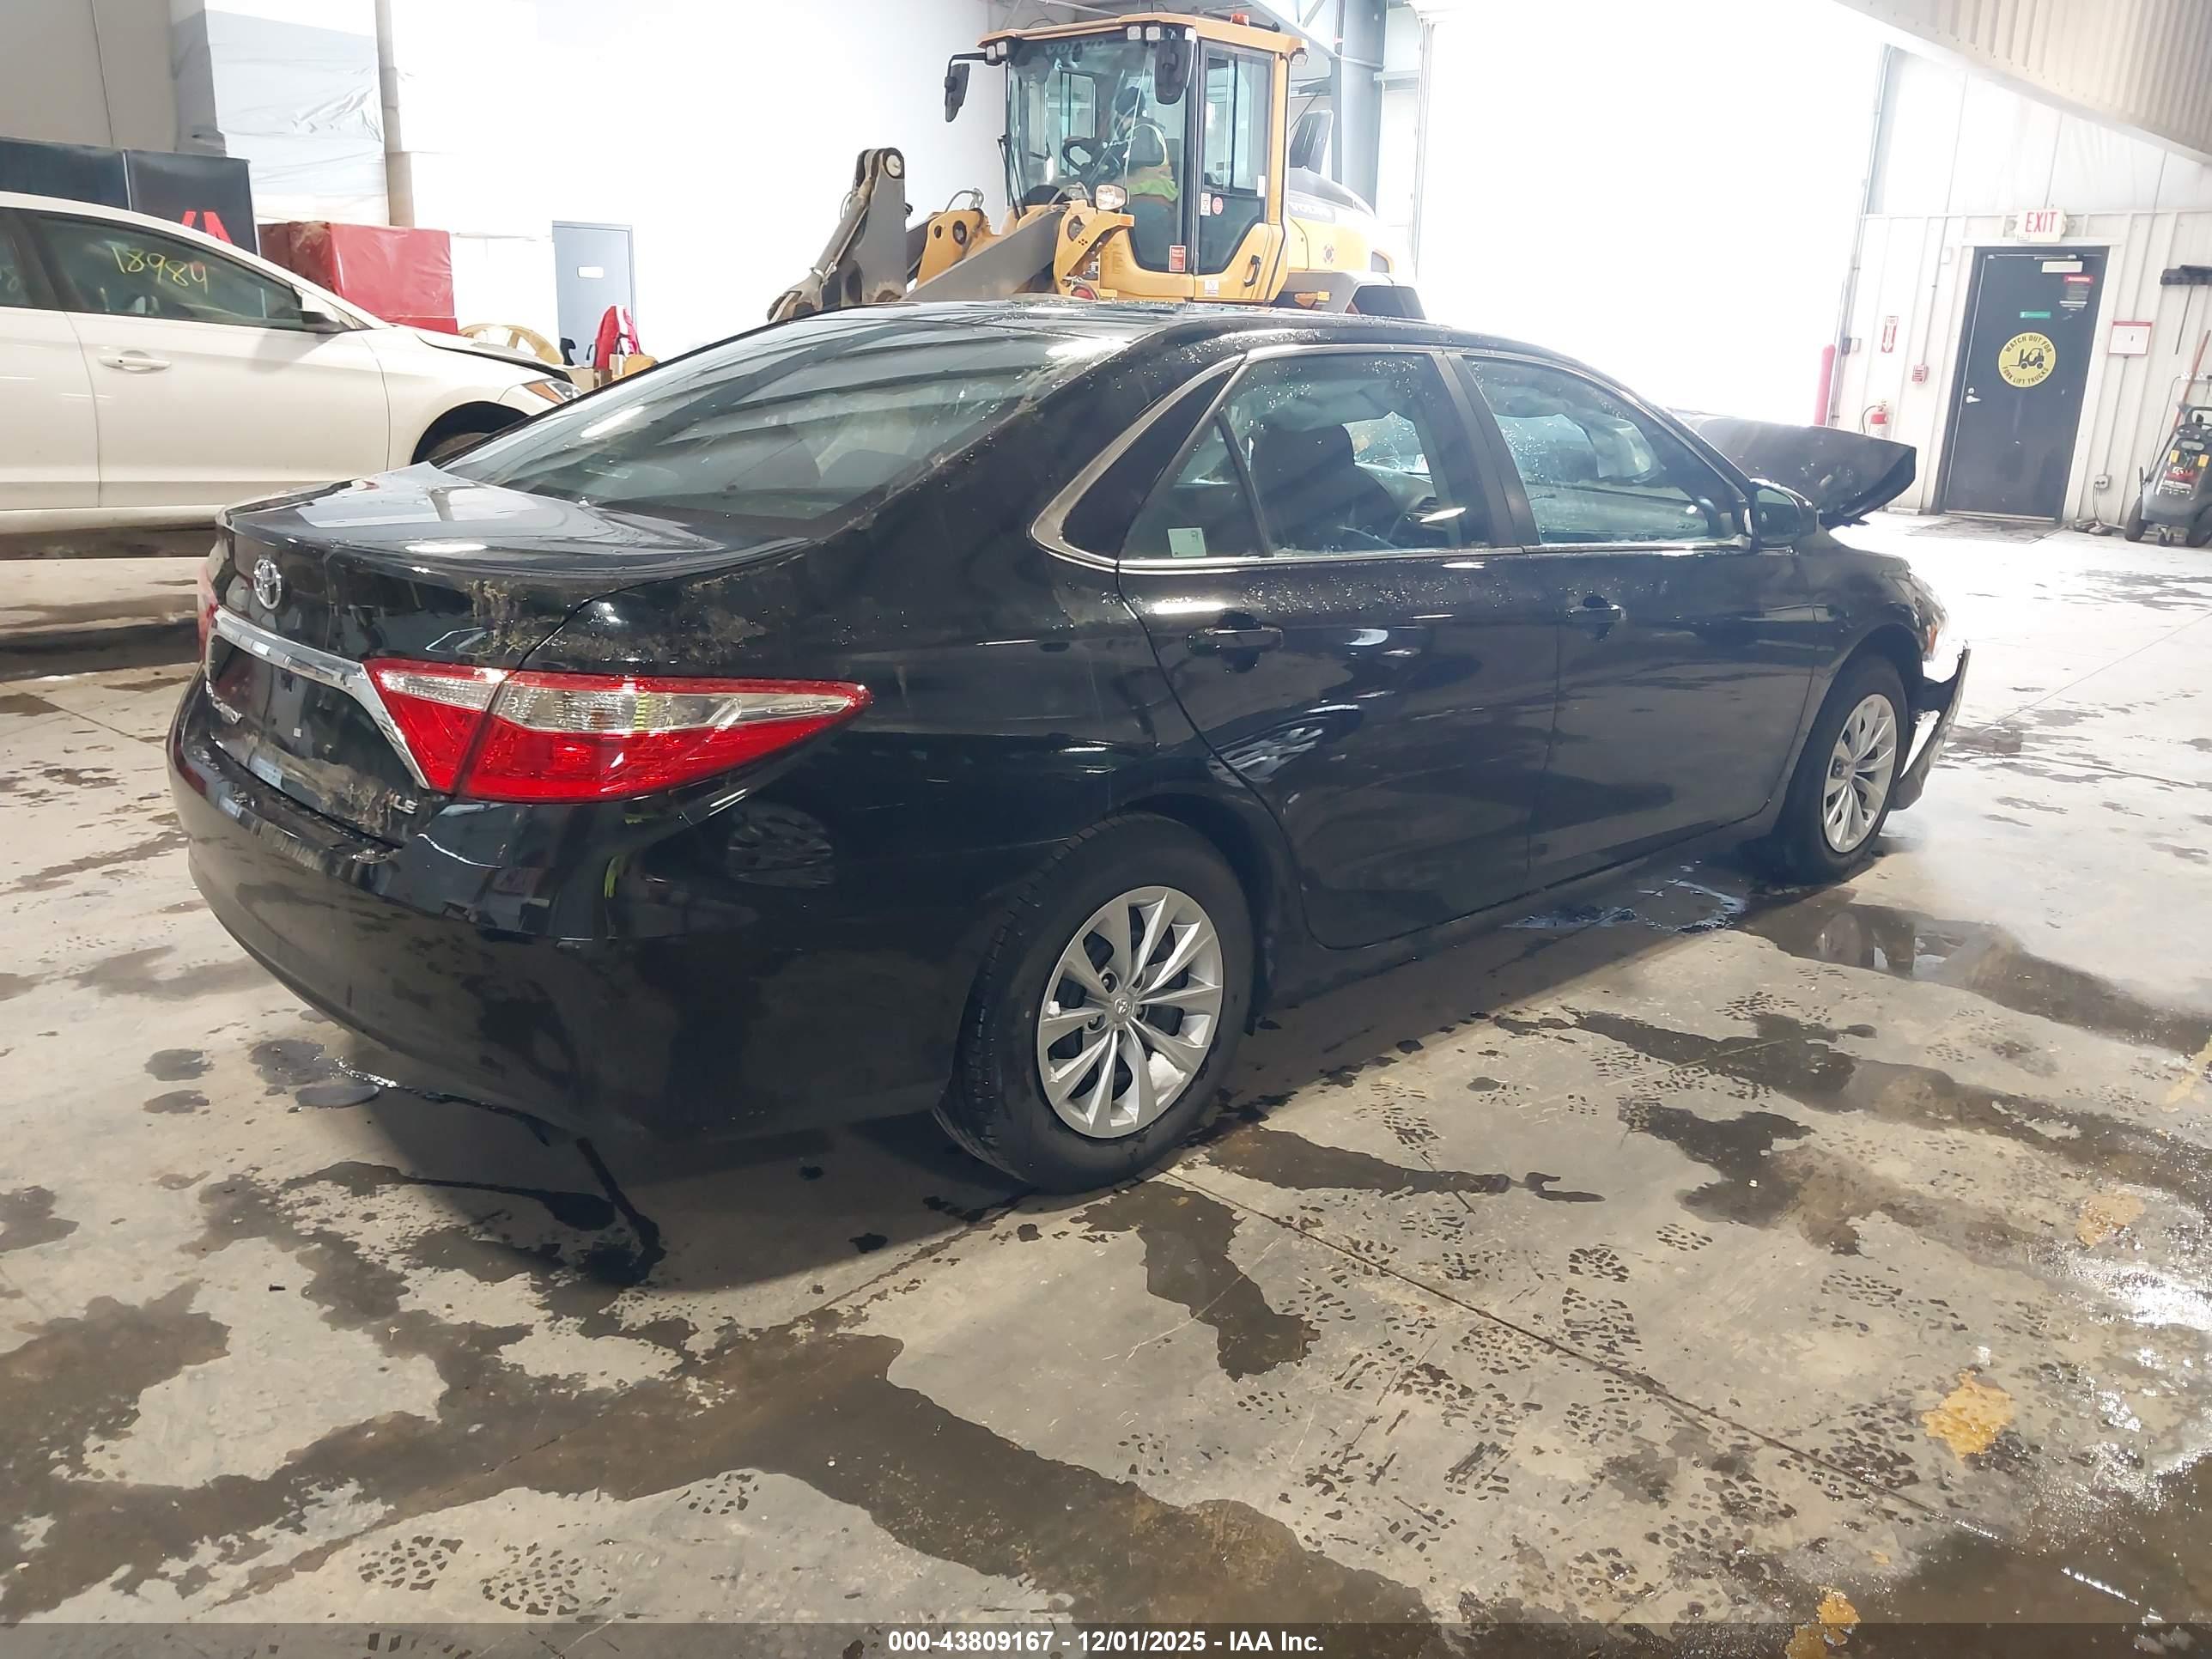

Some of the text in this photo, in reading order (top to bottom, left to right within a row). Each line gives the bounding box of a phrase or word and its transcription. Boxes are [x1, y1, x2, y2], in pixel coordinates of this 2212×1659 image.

[2025, 211, 2057, 233] EXIT
[112, 246, 209, 295] 18984
[2005, 337, 2027, 353] WATCH
[2041, 340, 2052, 353] FOR
[2002, 366, 2014, 380] FORK
[2027, 368, 2049, 385] TRUCKS
[394, 794, 419, 815] LE
